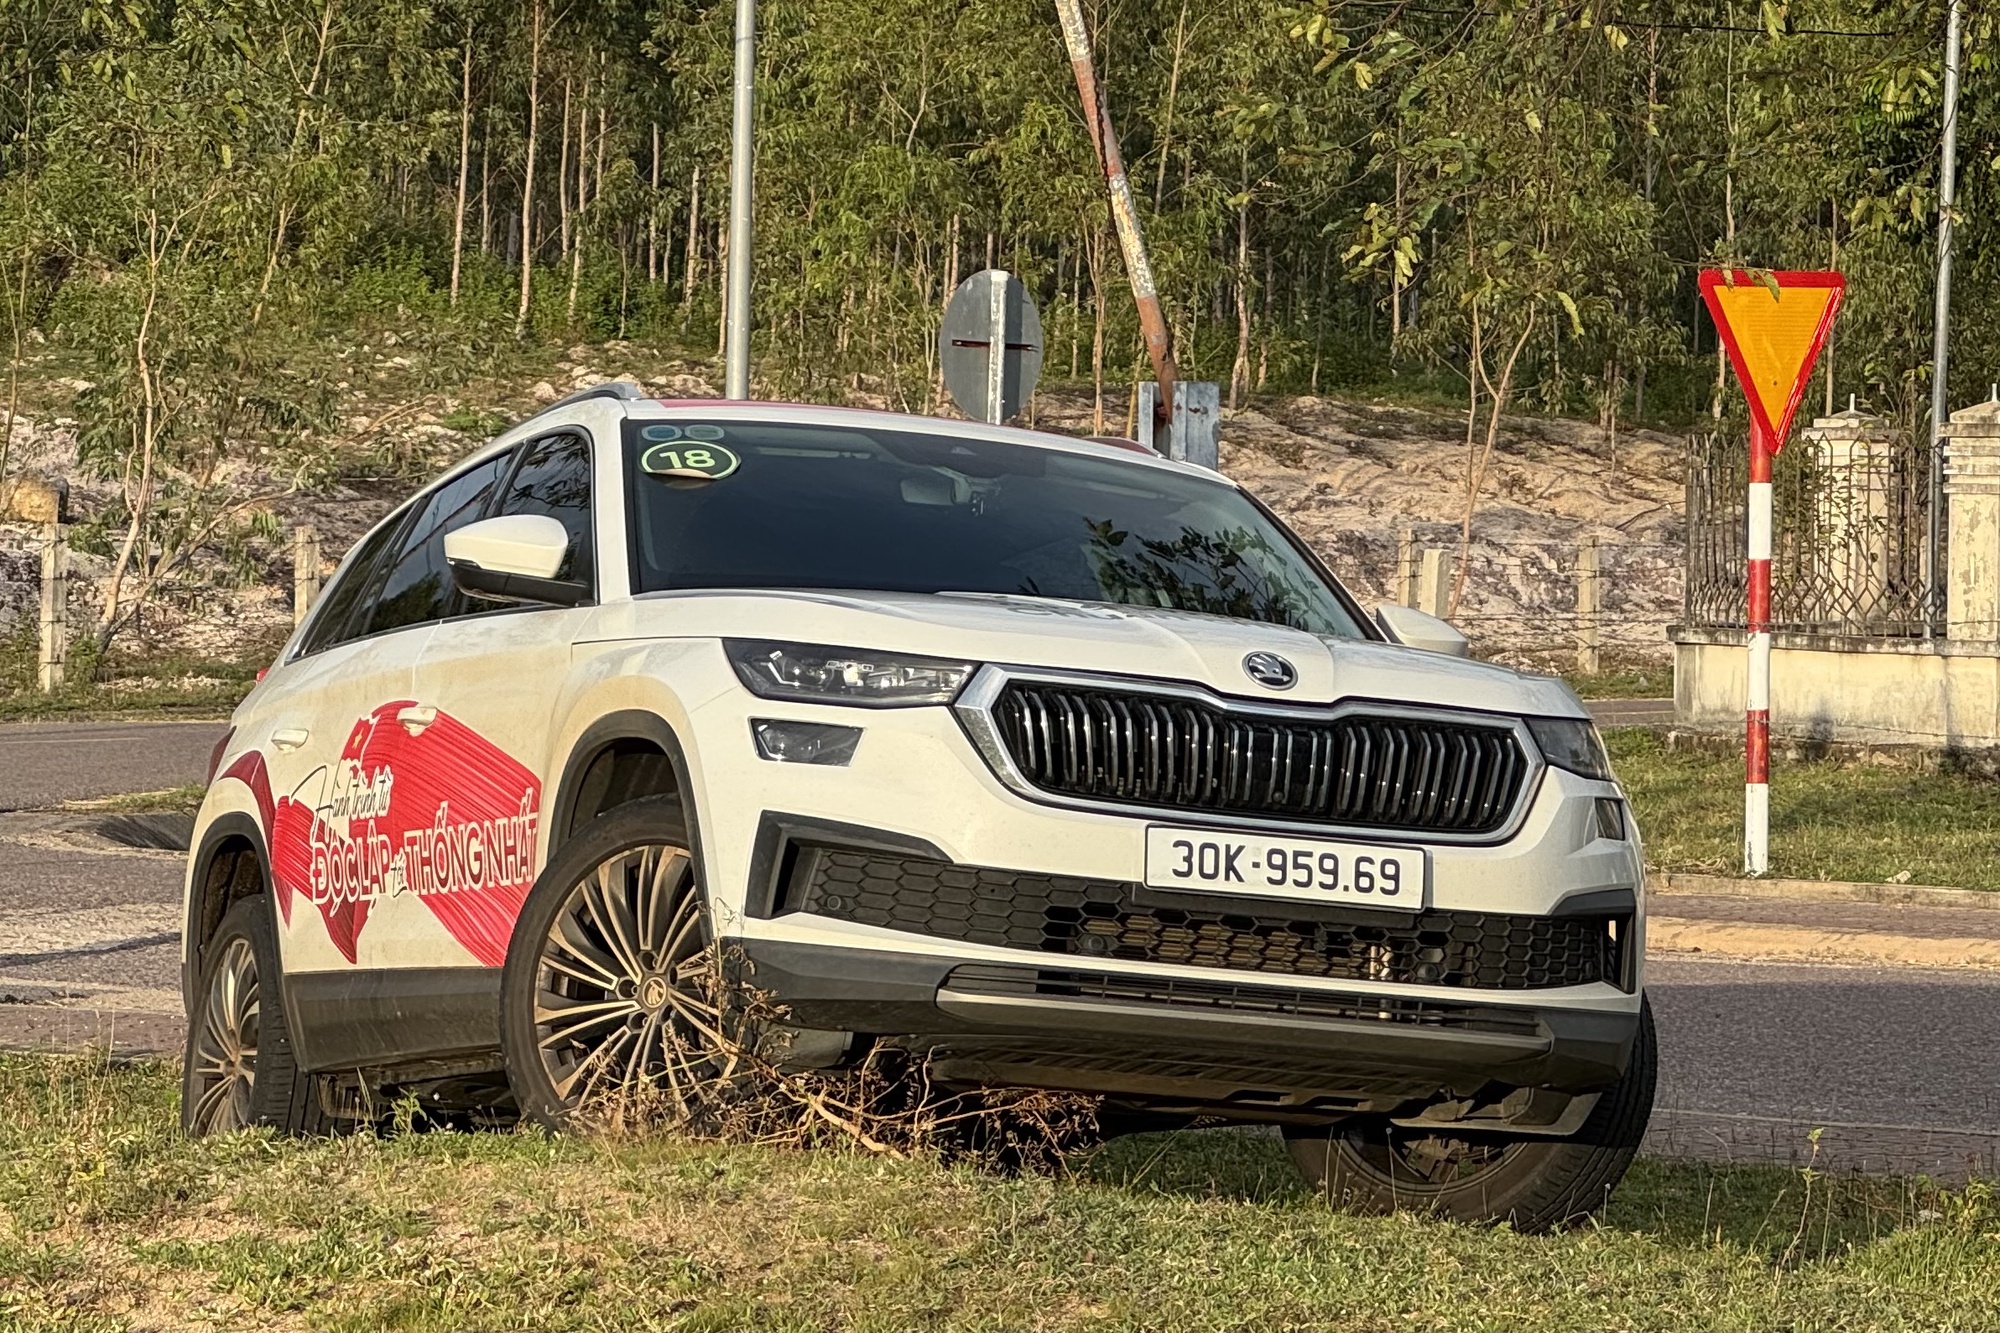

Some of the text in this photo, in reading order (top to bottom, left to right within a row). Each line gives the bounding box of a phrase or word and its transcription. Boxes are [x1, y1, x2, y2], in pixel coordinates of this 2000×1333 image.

[659, 449, 716, 469] 18
[404, 801, 484, 896] THỐNG
[483, 787, 538, 888] NHẤT
[1171, 839, 1401, 896] 30K-959.69
